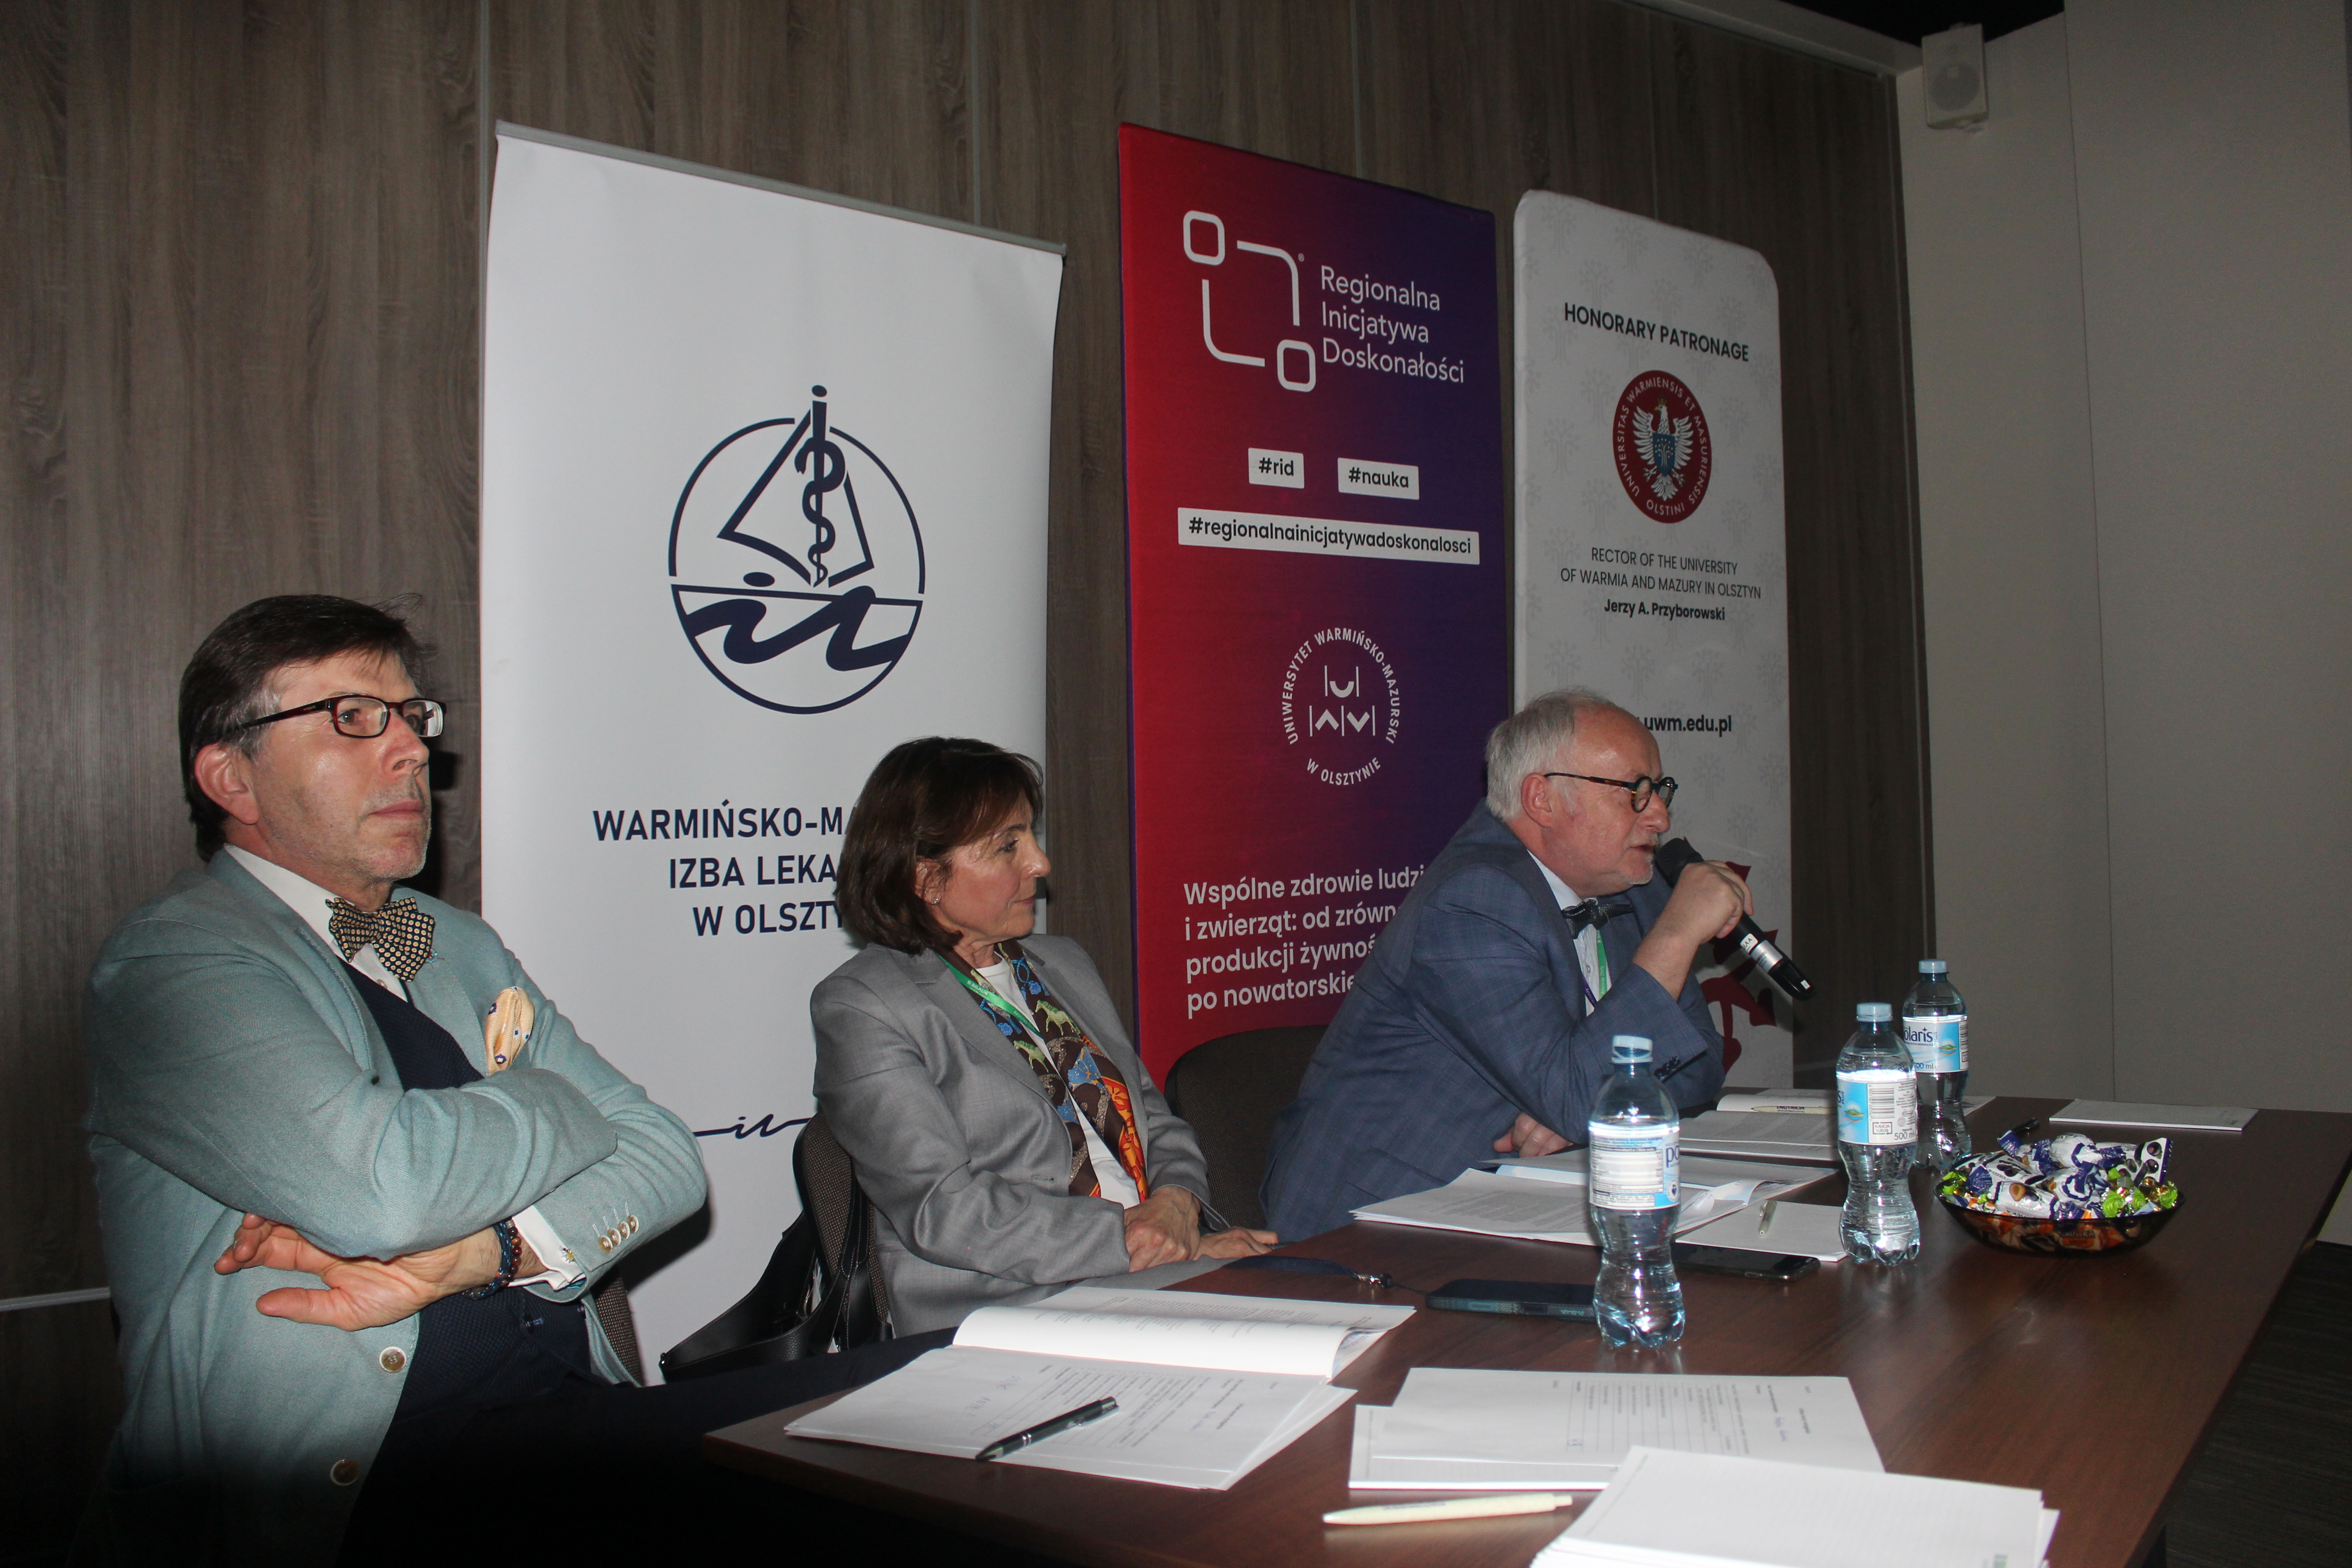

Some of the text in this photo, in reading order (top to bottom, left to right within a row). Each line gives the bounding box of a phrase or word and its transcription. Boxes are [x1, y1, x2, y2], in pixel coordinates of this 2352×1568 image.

[1321, 265, 1441, 312] Regionalna
[1322, 301, 1429, 345] Inicjatywa
[1564, 302, 1749, 362] HONORARY PATRONAGE
[1323, 337, 1464, 383] Doskonałości
[1617, 377, 1708, 505] UNIVERSITAS WARMIENSIS ET MASURIENSIS
[1258, 457, 1294, 477] #rid
[1348, 466, 1409, 489] #nauka
[1646, 500, 1685, 516] OLSTINI
[1188, 516, 1472, 555] #regionalnainicjatywadoskonalosci
[1591, 547, 1738, 575] RECTOR OF THE UNIVERSITY
[1560, 568, 1761, 599] OF WARMIA AND MAZURY IN OLSZTYN
[1604, 599, 1725, 621] Jerzy A. Przyborowski
[1282, 627, 1400, 745] UNIWERSYTET WARMIŃSKO-MAZURSKI
[1635, 715, 1732, 737] uwm.edu.pl
[1307, 757, 1381, 785] W OLSZTYNIE
[593, 799, 853, 841] WARMIŃSKO-M
[669, 854, 837, 889] IZBA LEKA
[1183, 876, 1285, 910] Wspólne
[1291, 869, 1373, 897] zdrowie
[692, 906, 724, 936] W
[1185, 901, 1400, 941] i zwierząt: od zrówn
[1186, 942, 1294, 984] produkcji
[971, 984, 988, 995] BRAUN
[1188, 991, 1217, 1019] po
[1894, 1132, 1907, 1140] 500
